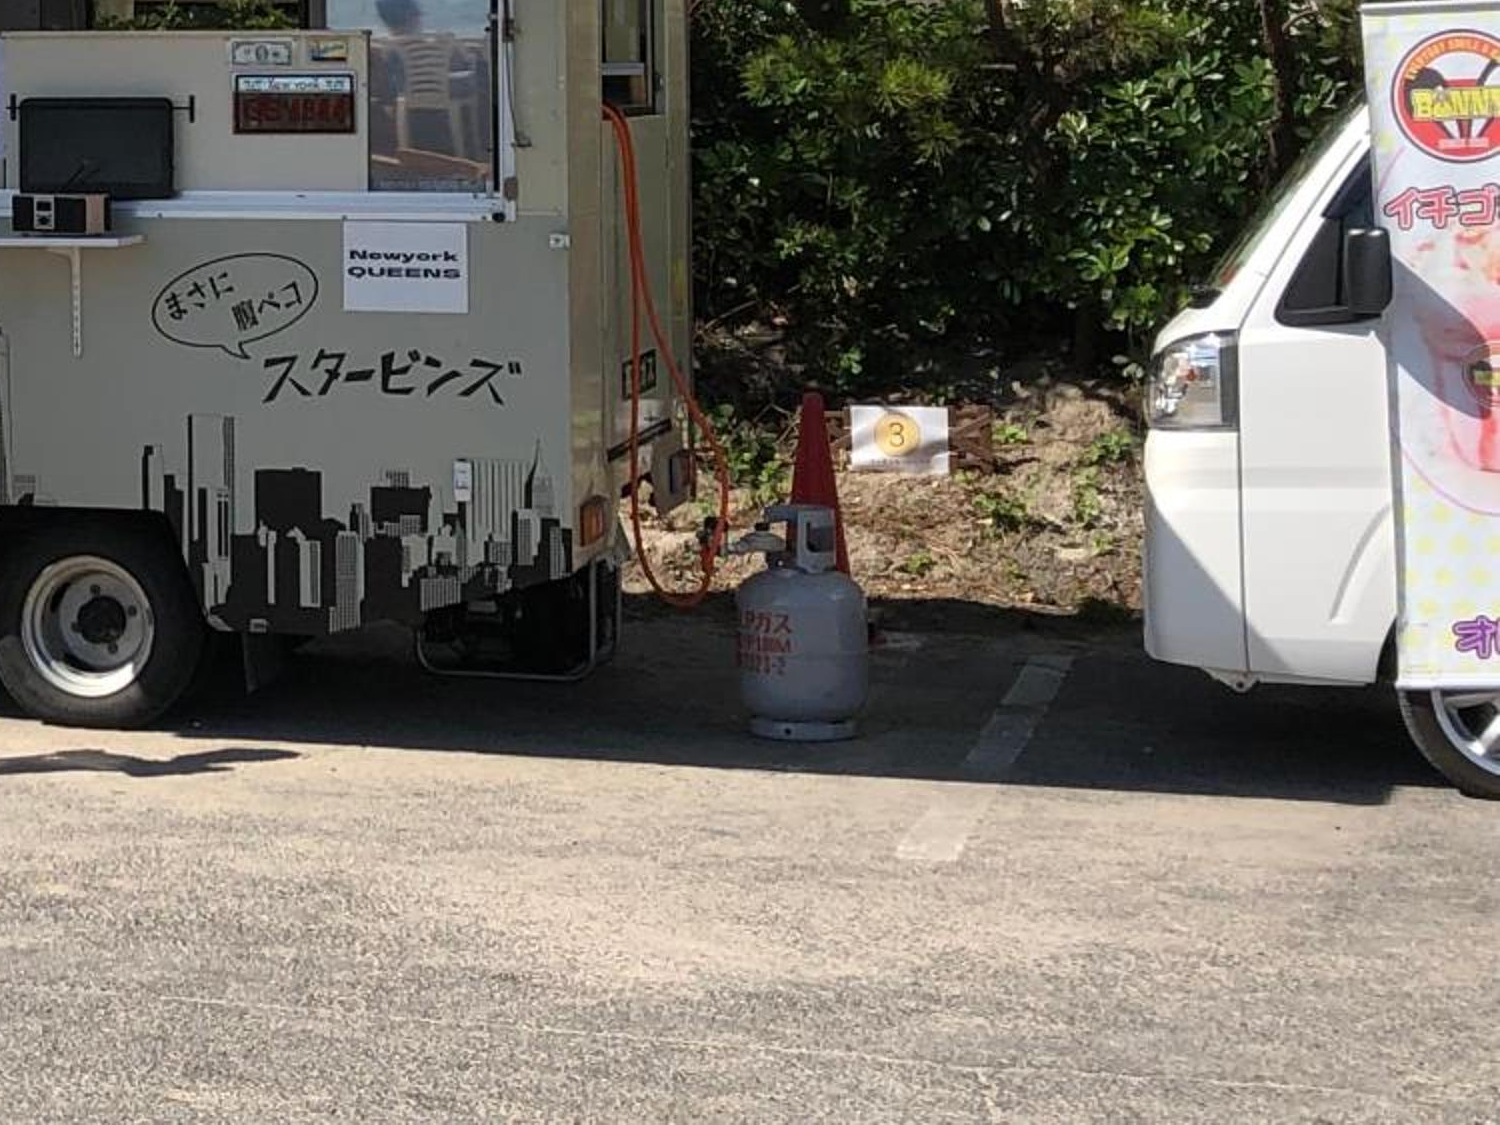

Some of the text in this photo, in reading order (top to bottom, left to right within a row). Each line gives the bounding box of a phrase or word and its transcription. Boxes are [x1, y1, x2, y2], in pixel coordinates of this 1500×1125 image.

[1384, 183, 1500, 229] イチゴ
[347, 266, 461, 279] QUEENS
[349, 249, 458, 263] Newyork
[164, 272, 235, 320] まさに
[262, 348, 522, 405] スタービンズ
[889, 421, 905, 448] 3
